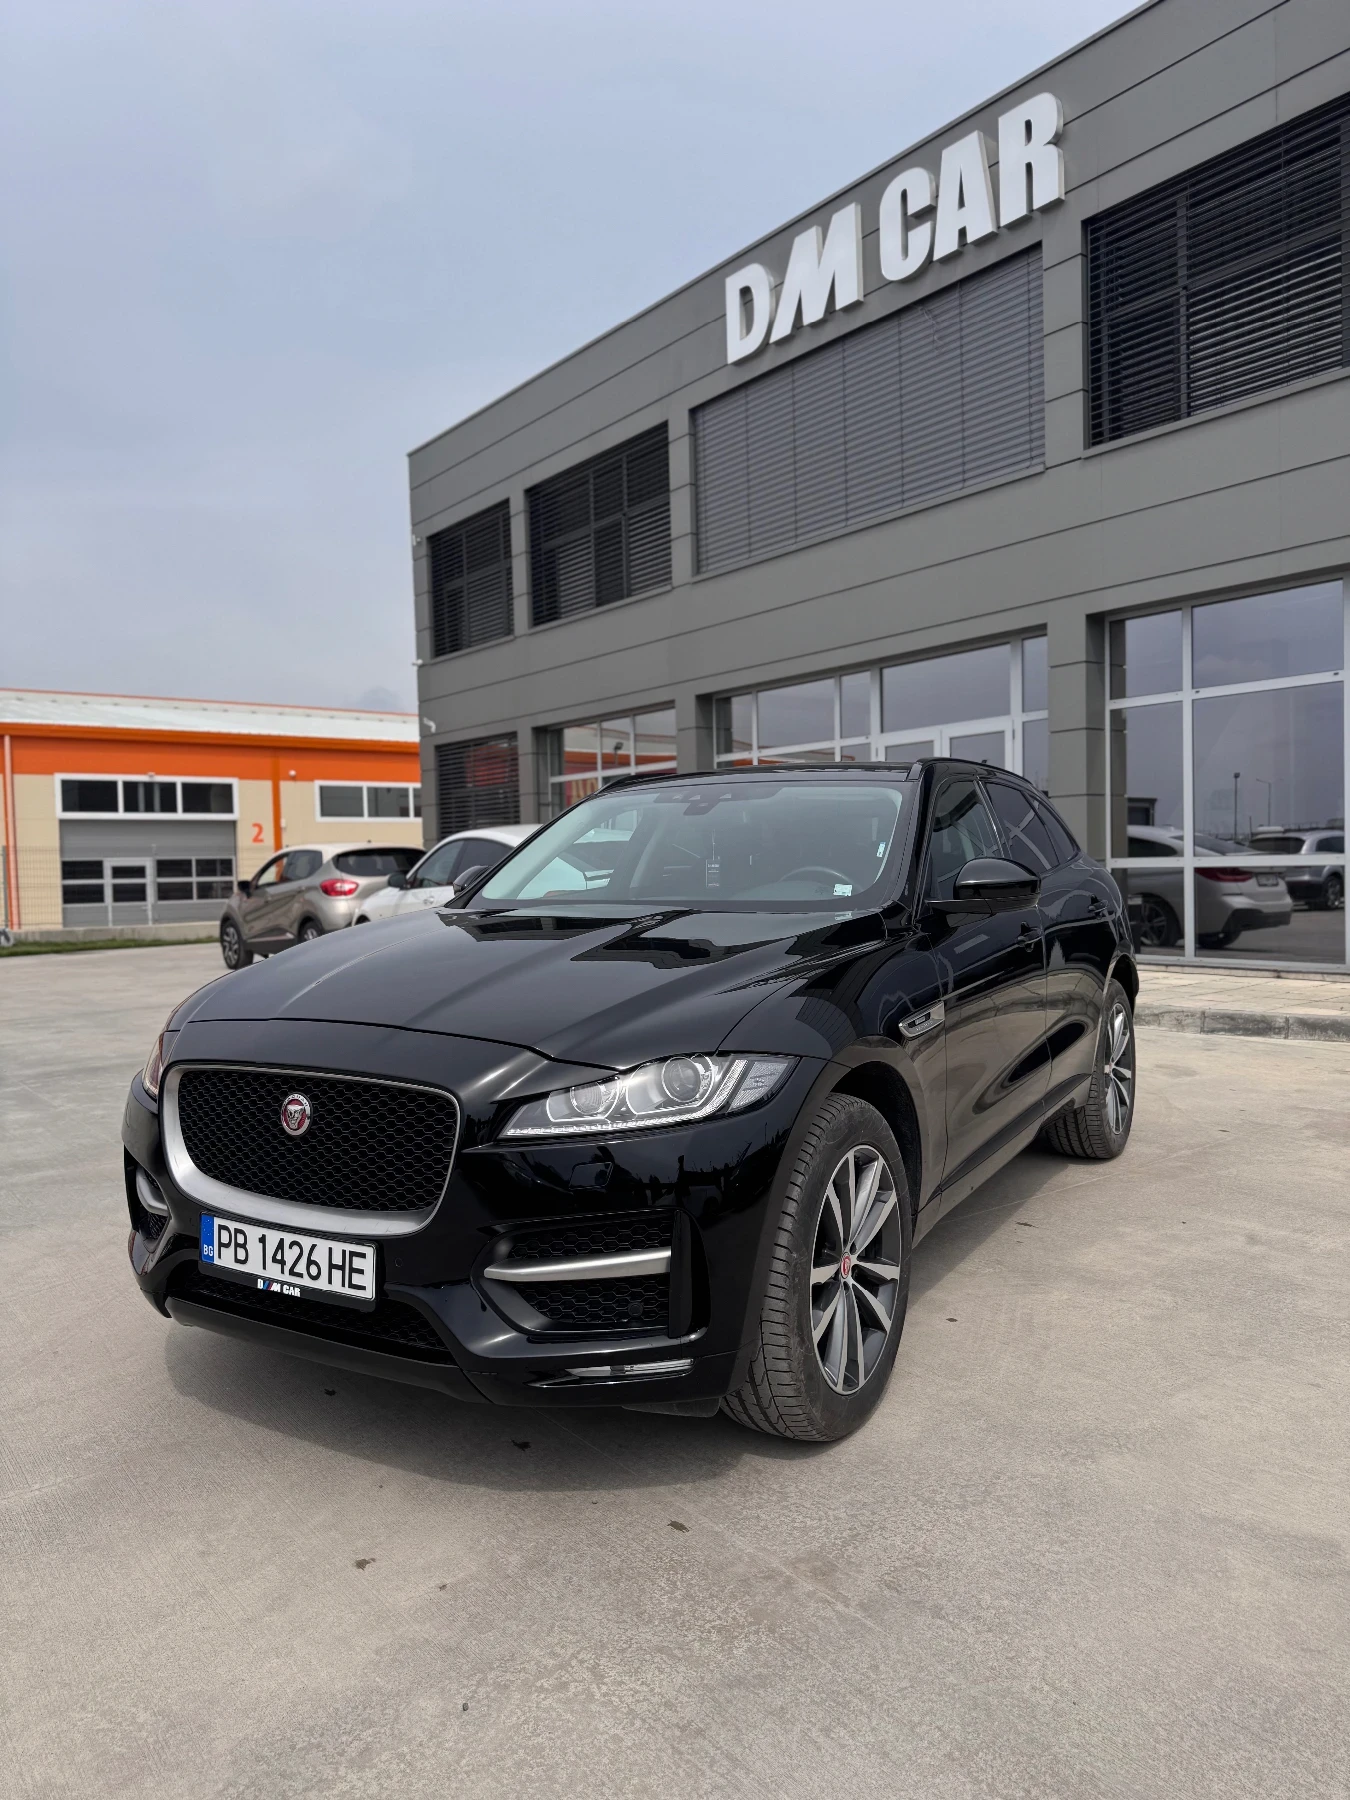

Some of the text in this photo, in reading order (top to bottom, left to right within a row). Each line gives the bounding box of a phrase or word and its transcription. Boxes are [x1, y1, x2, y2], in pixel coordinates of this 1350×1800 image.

[725, 92, 1065, 364] DM CAR
[251, 822, 264, 843] 2
[203, 1244, 213, 1257] BG
[218, 1224, 367, 1291] PB 1426 HE
[282, 1284, 301, 1297] CAR
